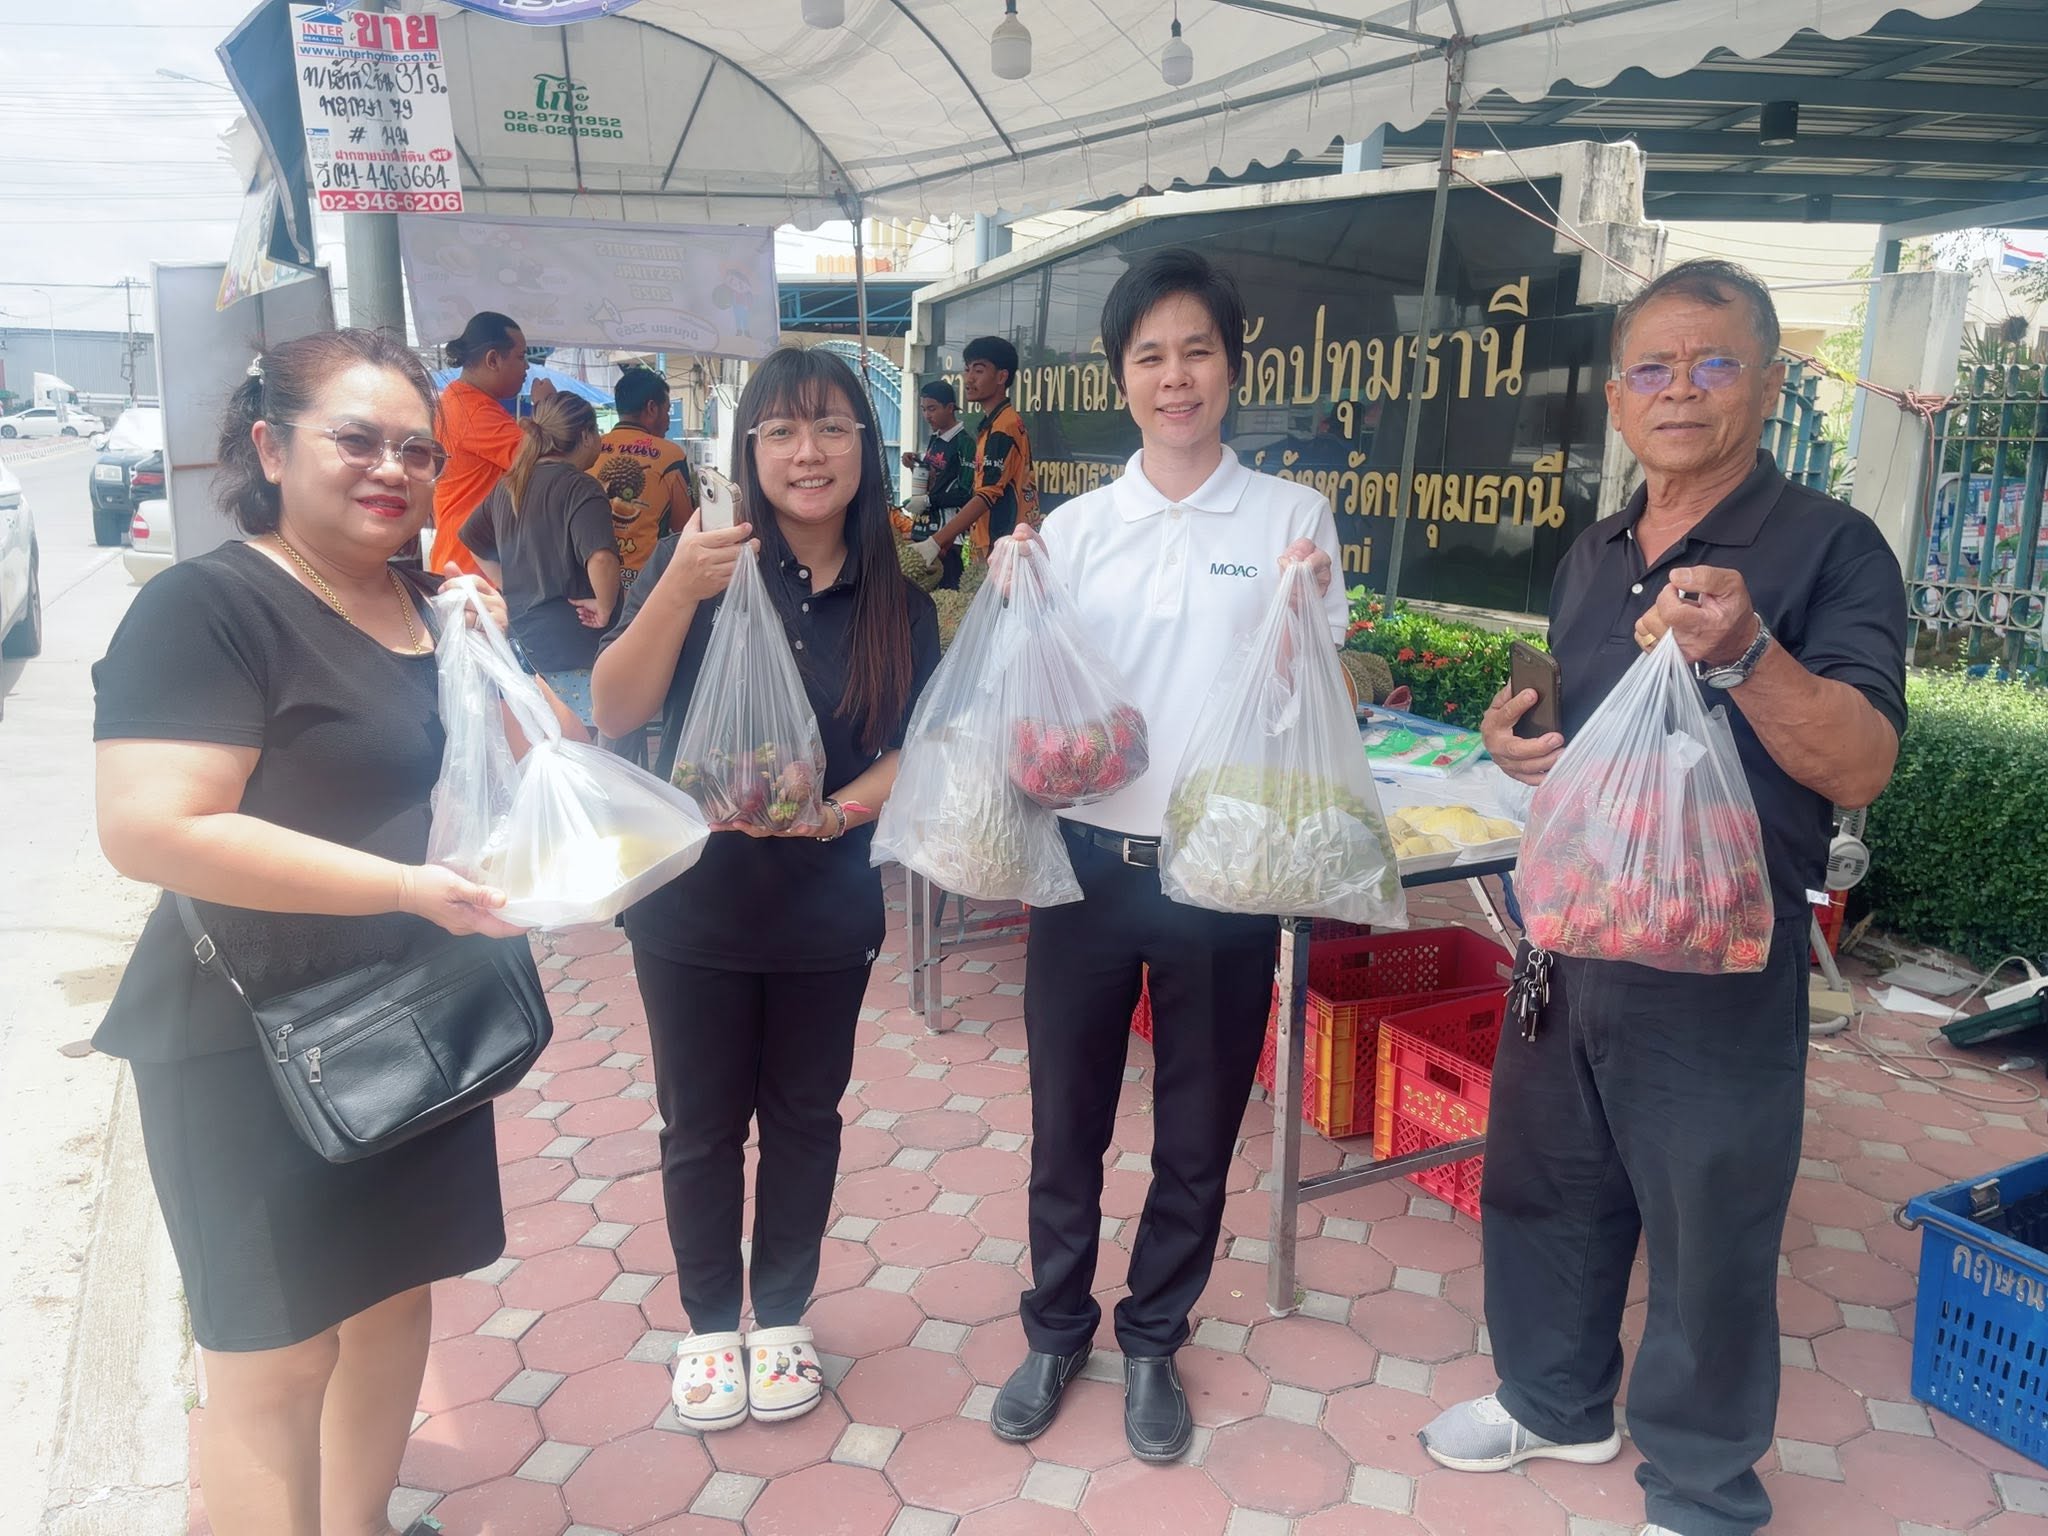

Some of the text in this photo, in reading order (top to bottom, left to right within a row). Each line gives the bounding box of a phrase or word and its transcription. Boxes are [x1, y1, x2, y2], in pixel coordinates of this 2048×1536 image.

[303, 23, 343, 36] INTER
[354, 12, 439, 49] ขาย
[300, 46, 437, 63] www.interhome.co.th
[389, 98, 413, 120] 79
[504, 110, 622, 127] 02-9791952
[504, 122, 623, 139] 086-0209590
[334, 162, 451, 191] 091-416-3664
[322, 192, 460, 211] 02-946-6206
[1210, 563, 1258, 578] MOAC
